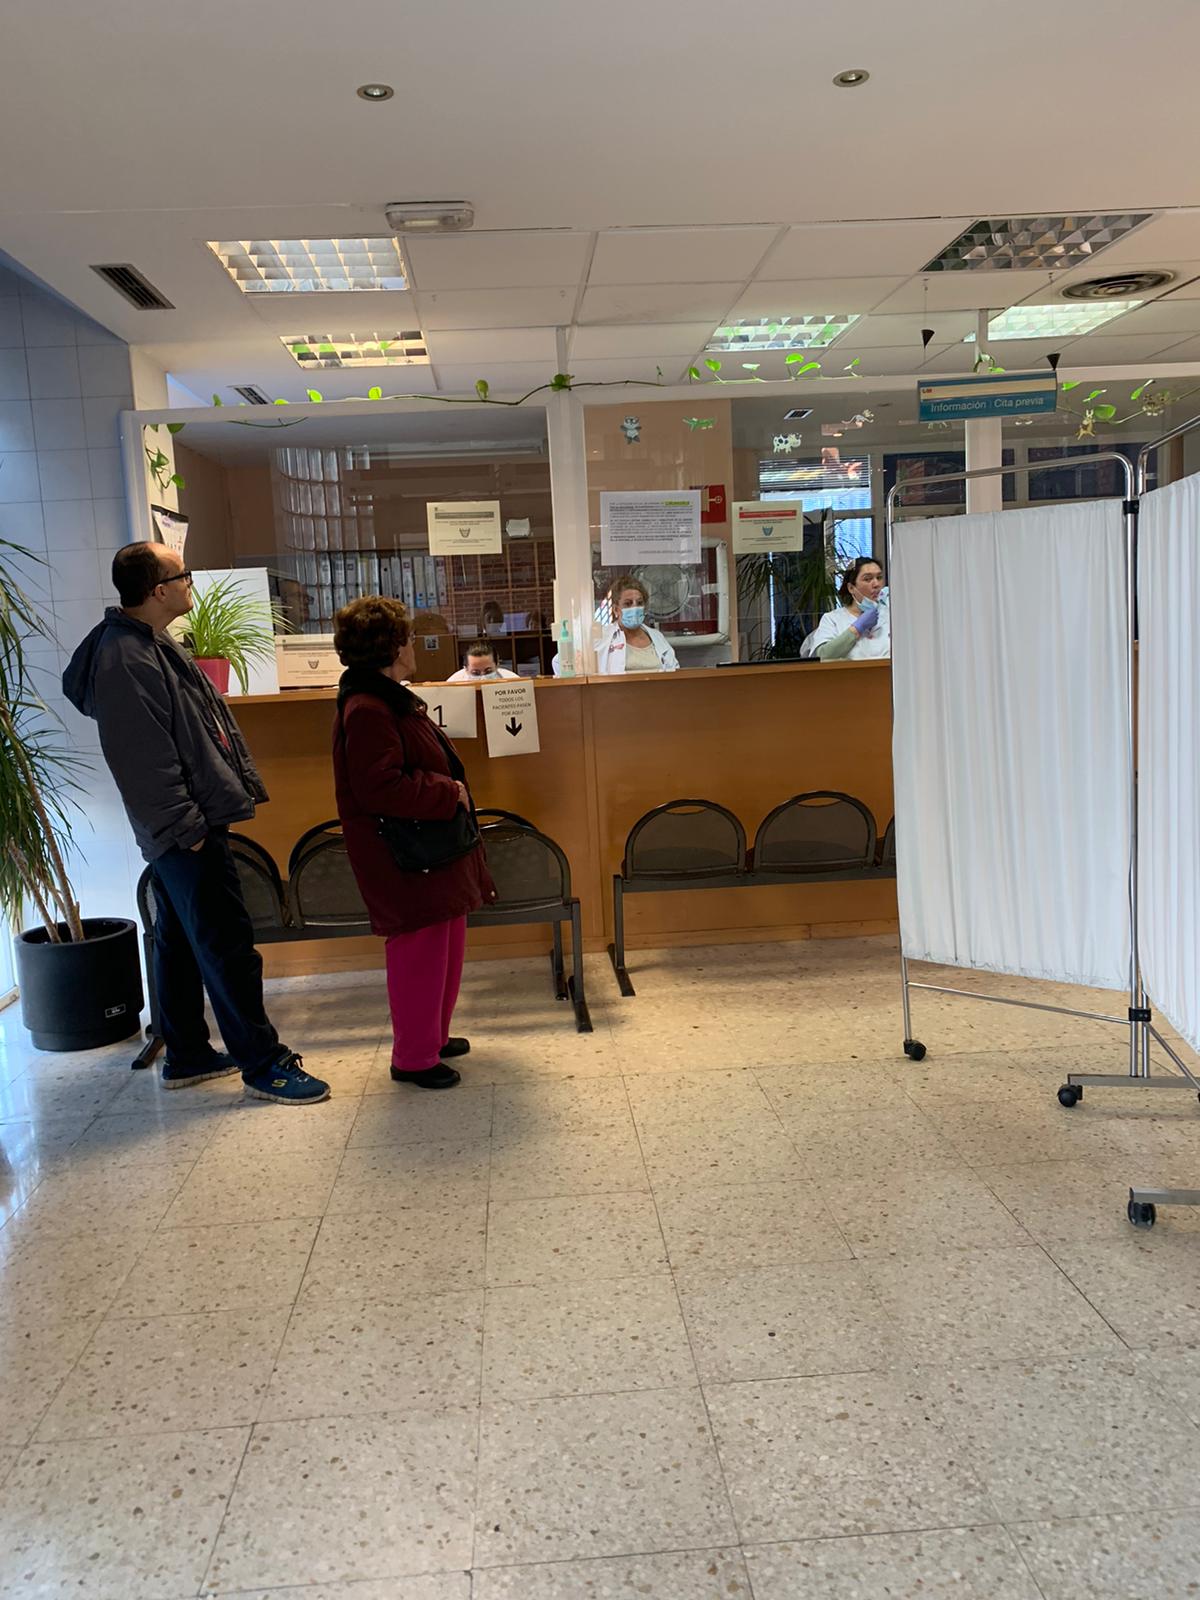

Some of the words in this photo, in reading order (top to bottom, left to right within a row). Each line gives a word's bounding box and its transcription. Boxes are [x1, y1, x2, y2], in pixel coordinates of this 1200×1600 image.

[931, 400, 986, 413] Información
[994, 398, 1014, 408] Cita
[1015, 396, 1044, 409] previa
